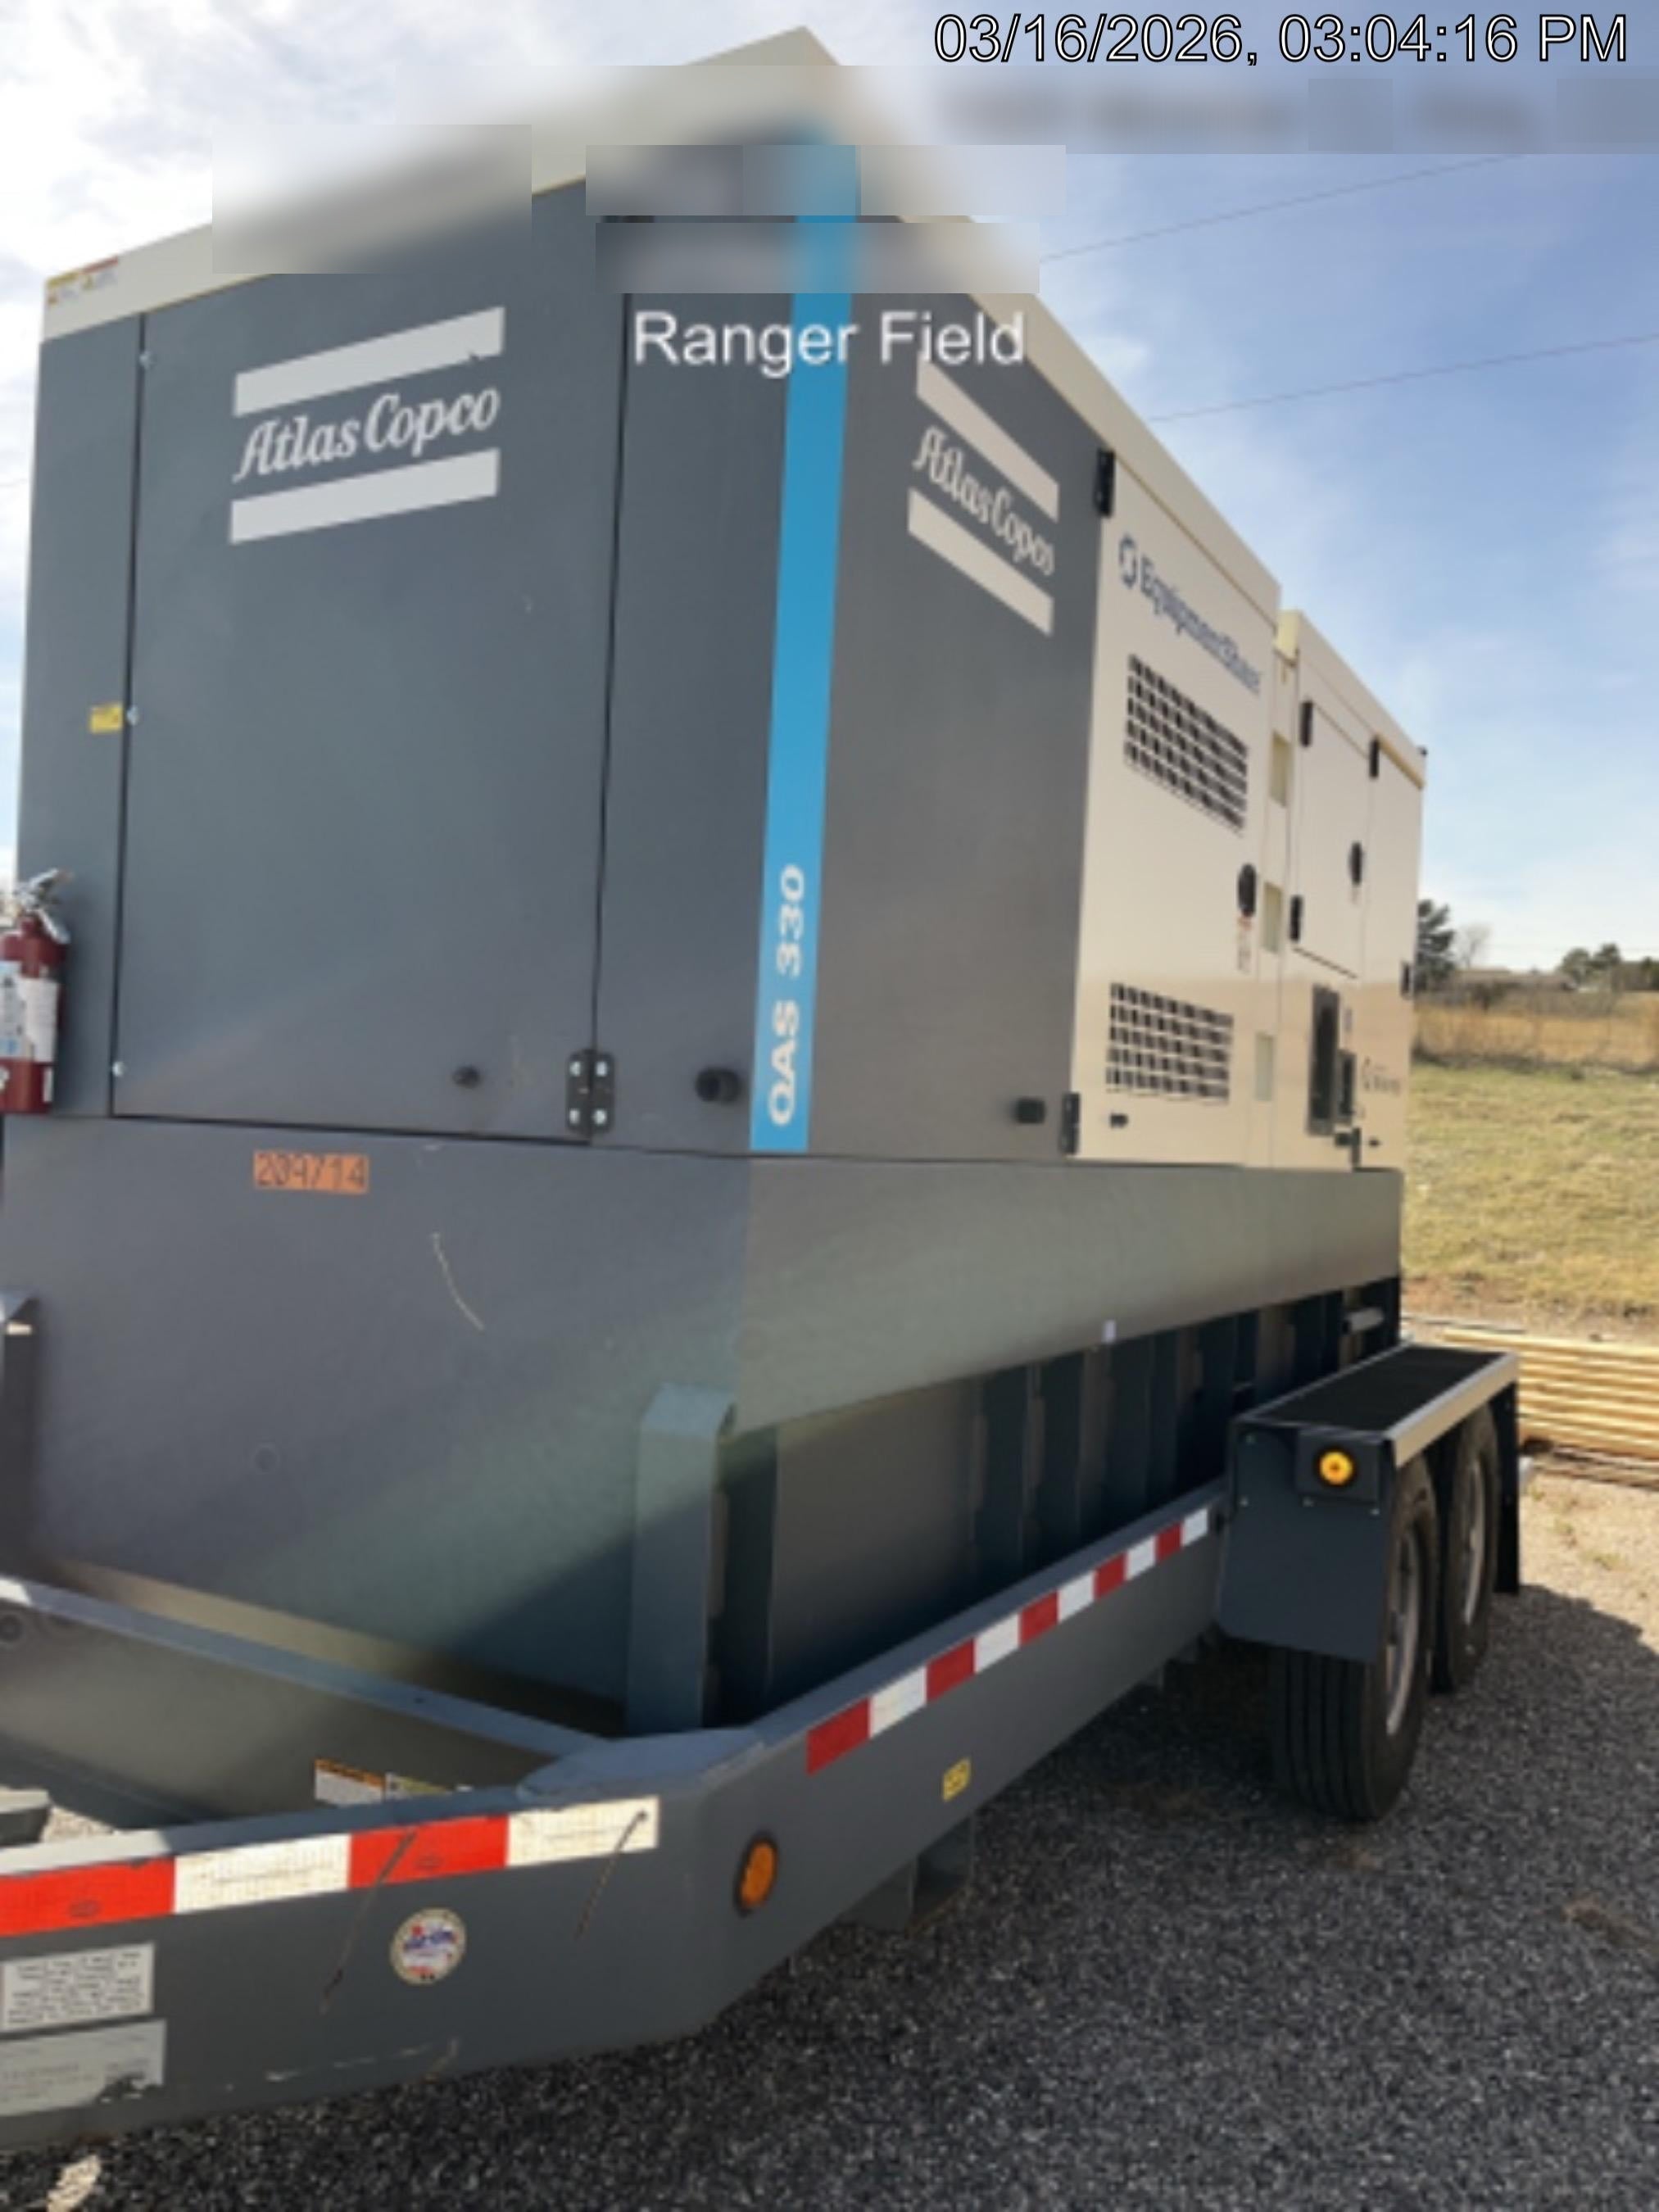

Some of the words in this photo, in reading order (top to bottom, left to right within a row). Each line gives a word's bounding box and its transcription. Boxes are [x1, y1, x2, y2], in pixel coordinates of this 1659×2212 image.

[233, 415, 360, 483] Atlas
[364, 388, 501, 457] Copco
[912, 426, 993, 524] Atlas
[990, 487, 1055, 576] Copco
[777, 863, 805, 977] 330
